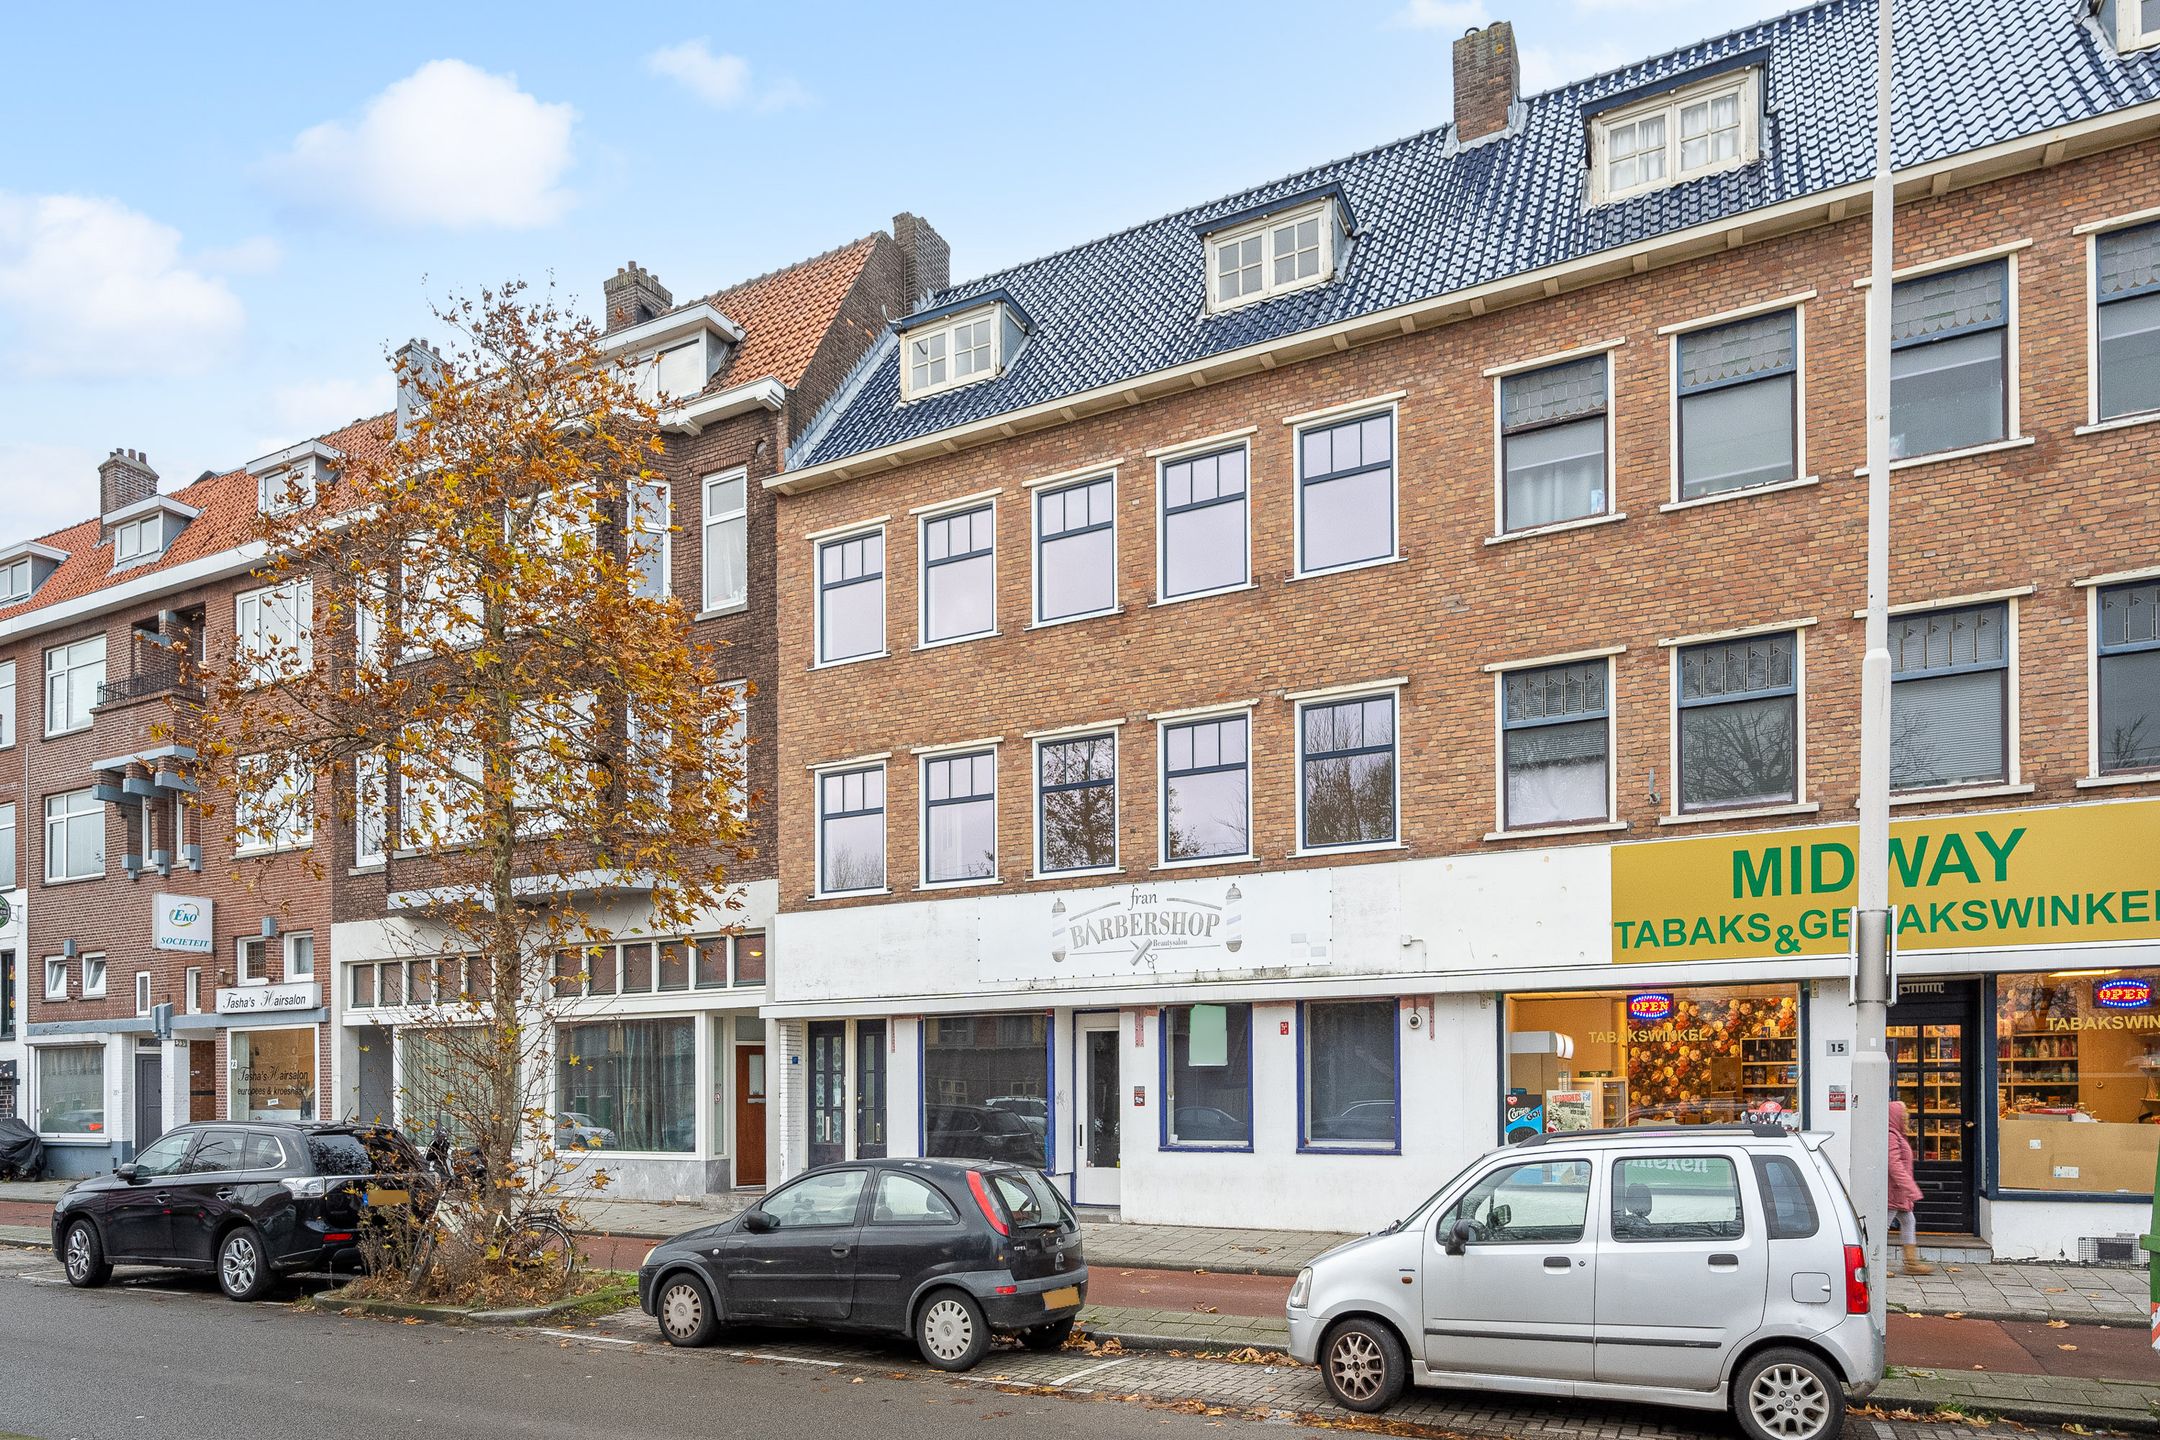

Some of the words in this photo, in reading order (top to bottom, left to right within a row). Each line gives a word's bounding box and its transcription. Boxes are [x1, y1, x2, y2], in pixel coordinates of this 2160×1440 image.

[1733, 828, 2027, 899] MIDWAY
[1128, 888, 1157, 911] fran
[1070, 911, 1220, 949] BARBERSHOP
[160, 937, 209, 948] SOCIETEIT
[223, 992, 255, 1009] Tasha's
[260, 990, 306, 1008] Hairsalon
[2099, 988, 2150, 1000] OPEN
[1631, 1001, 1670, 1012] OPEN
[1588, 1028, 1708, 1043] TABAKSWINKEL
[1831, 1043, 1844, 1052] 15
[266, 1086, 271, 1095] &
